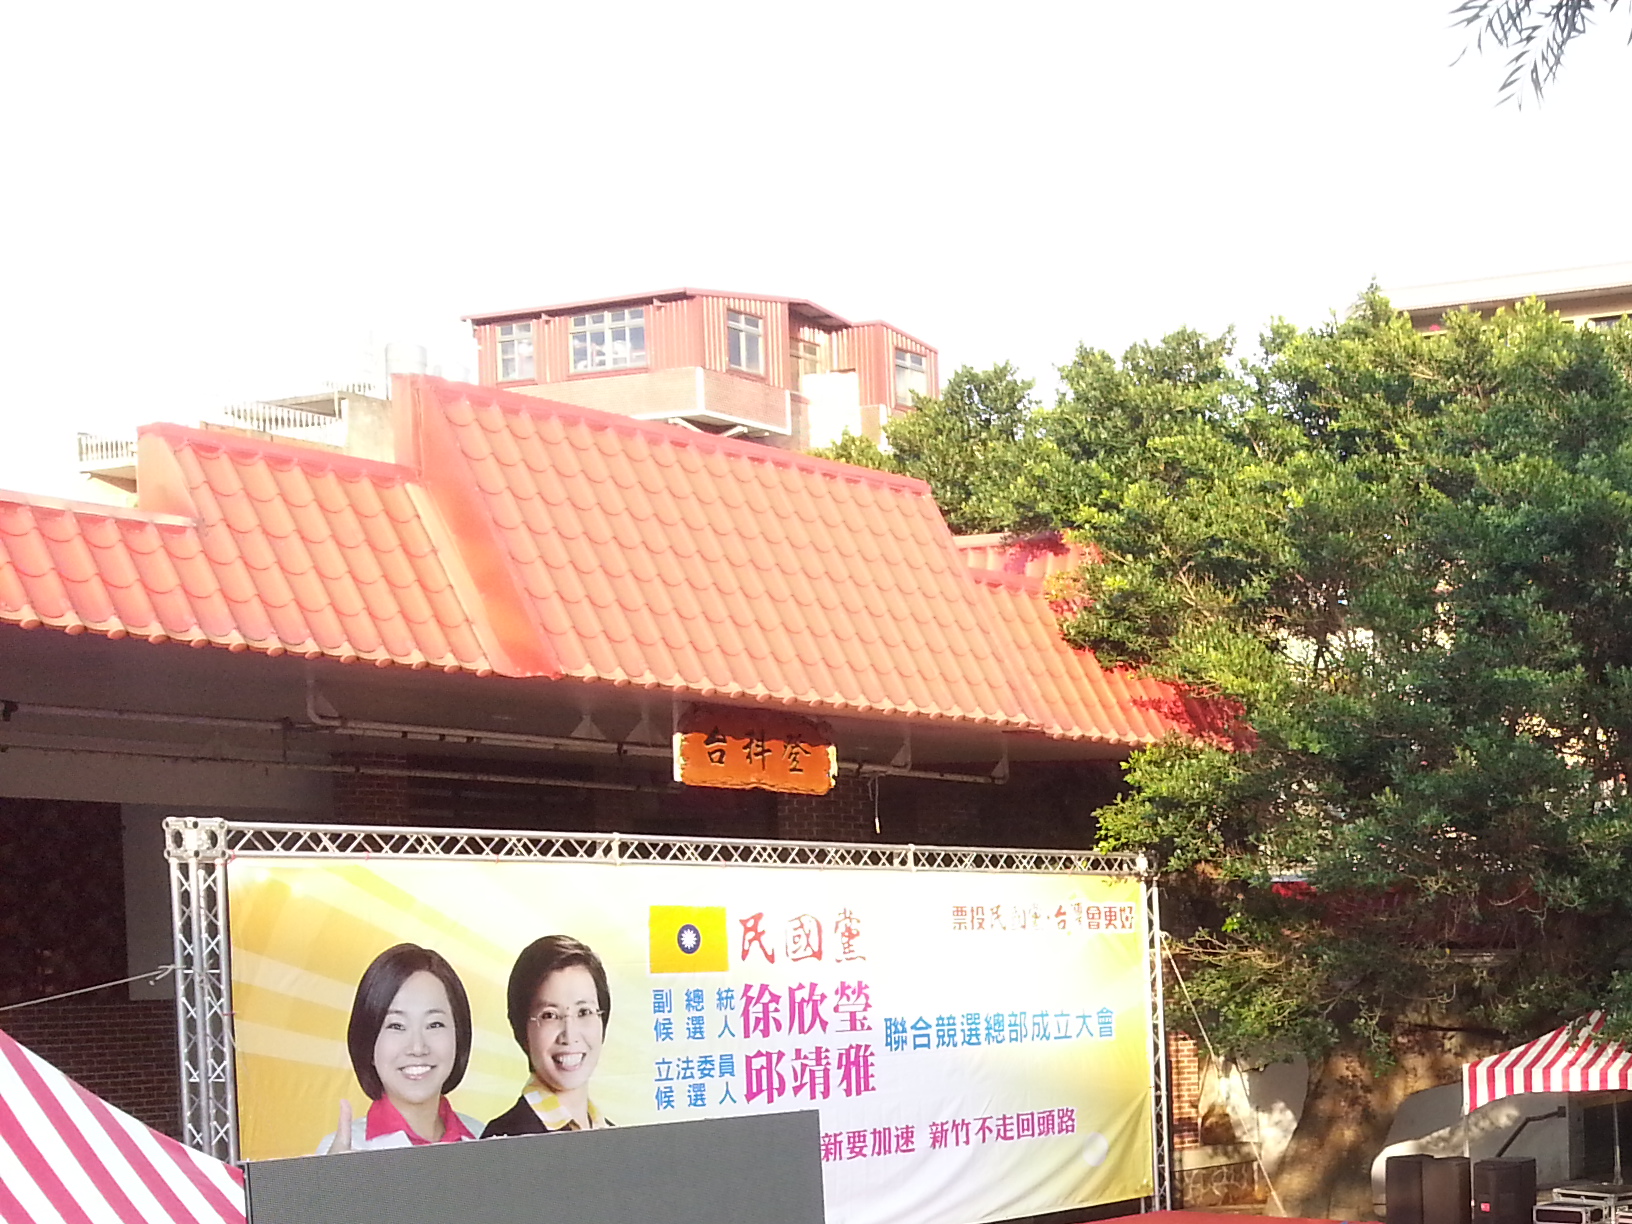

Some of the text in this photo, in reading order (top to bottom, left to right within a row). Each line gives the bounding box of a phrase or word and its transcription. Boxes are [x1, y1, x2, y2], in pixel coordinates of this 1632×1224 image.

[738, 907, 867, 964] 民國黨
[652, 987, 736, 1015] 副總統
[740, 980, 873, 1039] 徐欣瑩
[653, 1014, 736, 1042] 候選人
[884, 1006, 1114, 1052] 聯合競選總部成立大會
[654, 1053, 736, 1083] 立法委員
[743, 1043, 877, 1104] 邱靖雅
[654, 1081, 737, 1110] 候選人
[928, 1107, 1076, 1150] 新竹不走回頭路
